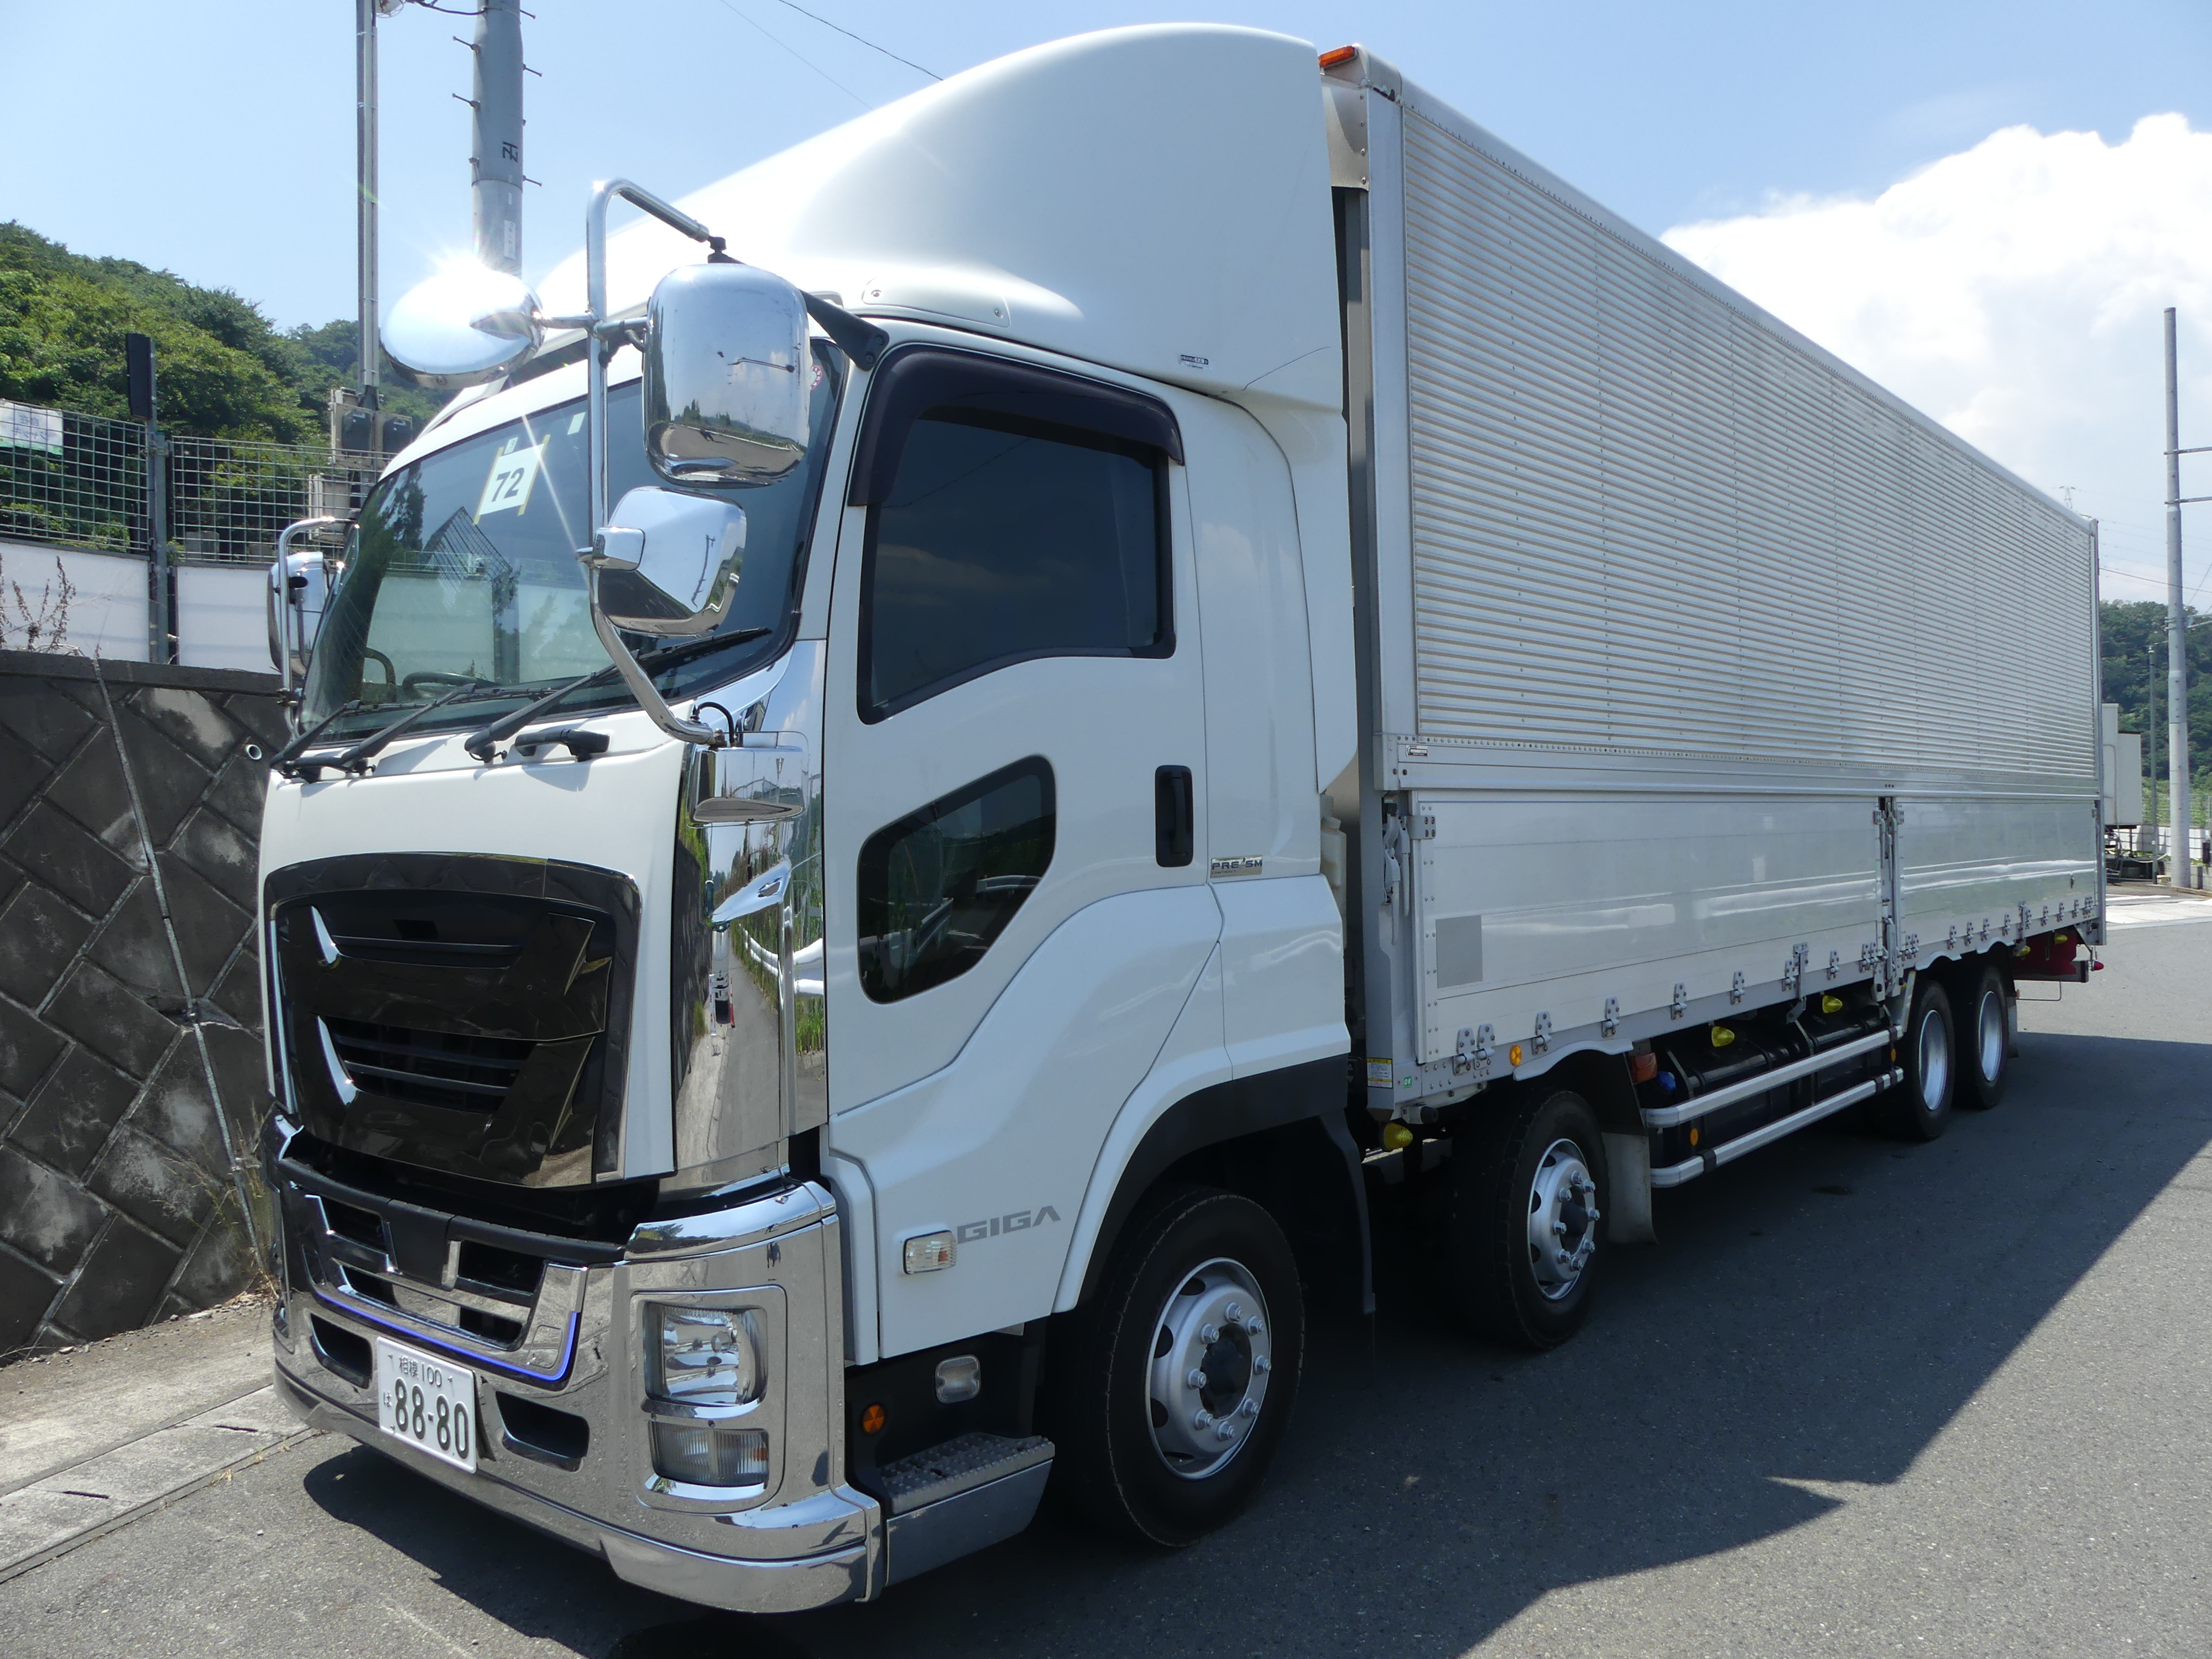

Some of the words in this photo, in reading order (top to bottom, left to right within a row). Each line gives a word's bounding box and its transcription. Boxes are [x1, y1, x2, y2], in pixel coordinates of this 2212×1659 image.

[491, 467, 525, 503] 72
[957, 1205, 1061, 1244] GIGA
[421, 1362, 442, 1388] 100
[395, 1376, 469, 1459] 88-80
